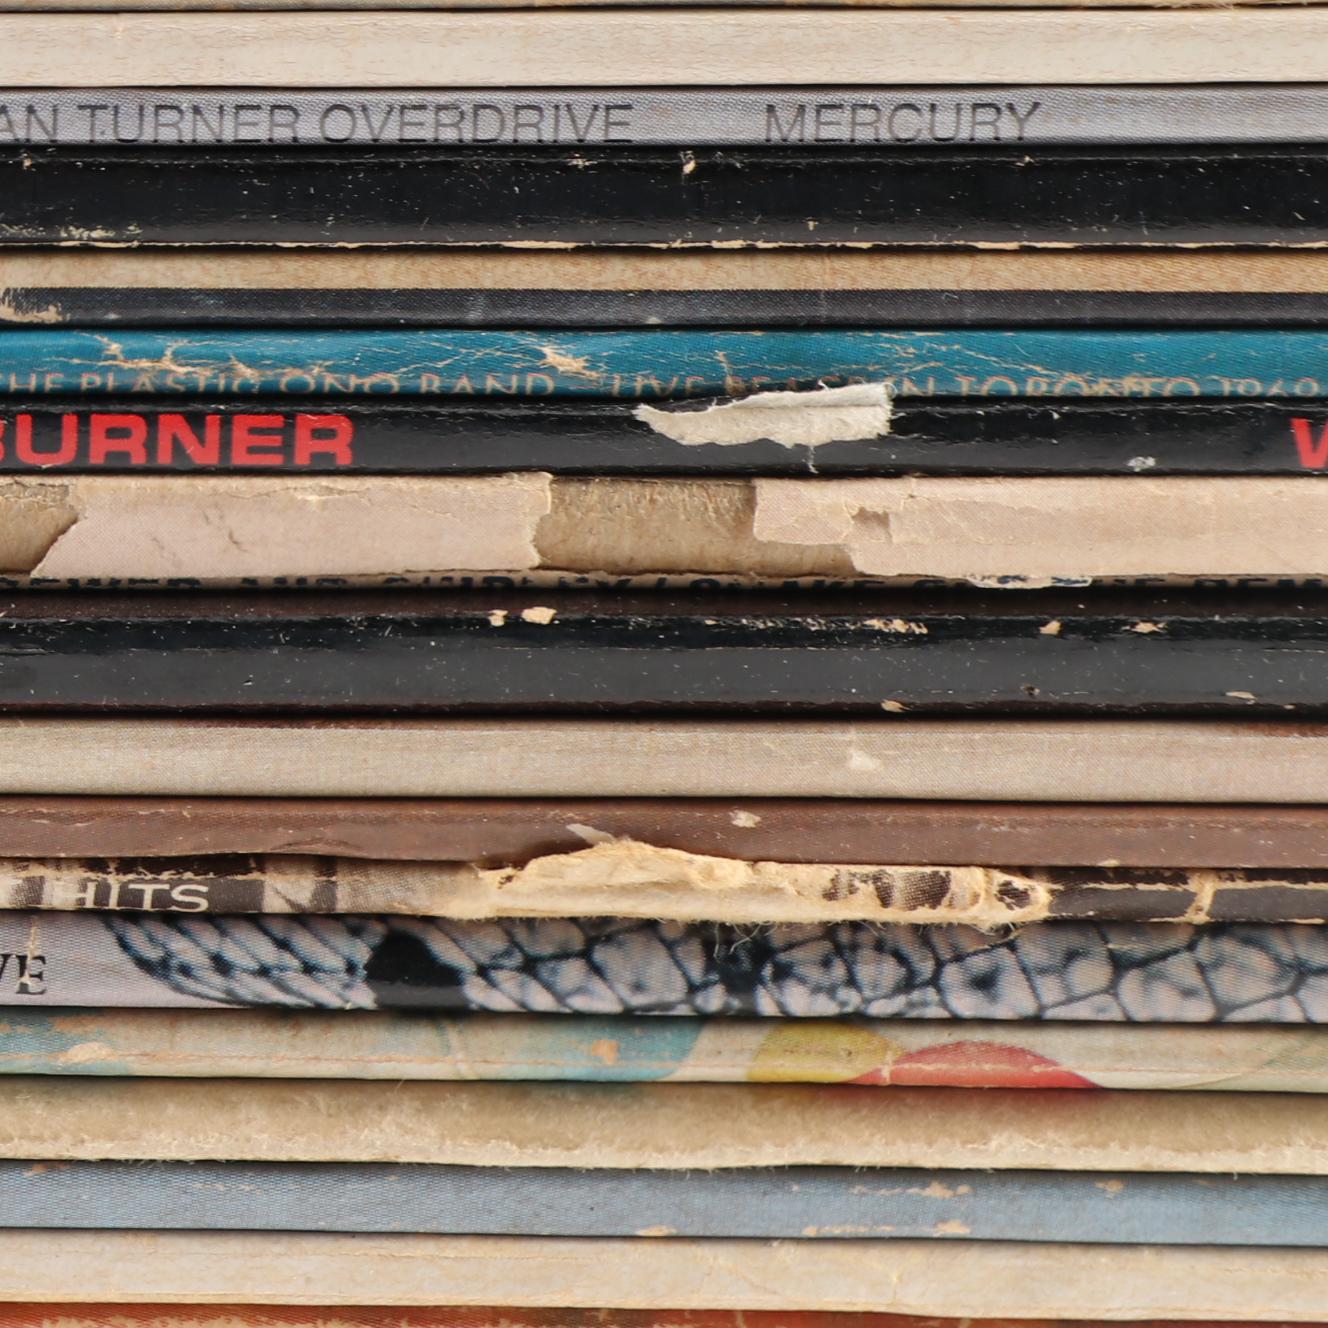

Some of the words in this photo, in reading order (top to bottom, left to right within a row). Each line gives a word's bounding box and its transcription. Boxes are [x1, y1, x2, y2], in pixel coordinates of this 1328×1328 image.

[77, 102, 302, 144] TURNER
[318, 102, 634, 144] OVERDRIVE
[763, 101, 1043, 144] MERCURY
[68, 882, 212, 913] HITS
